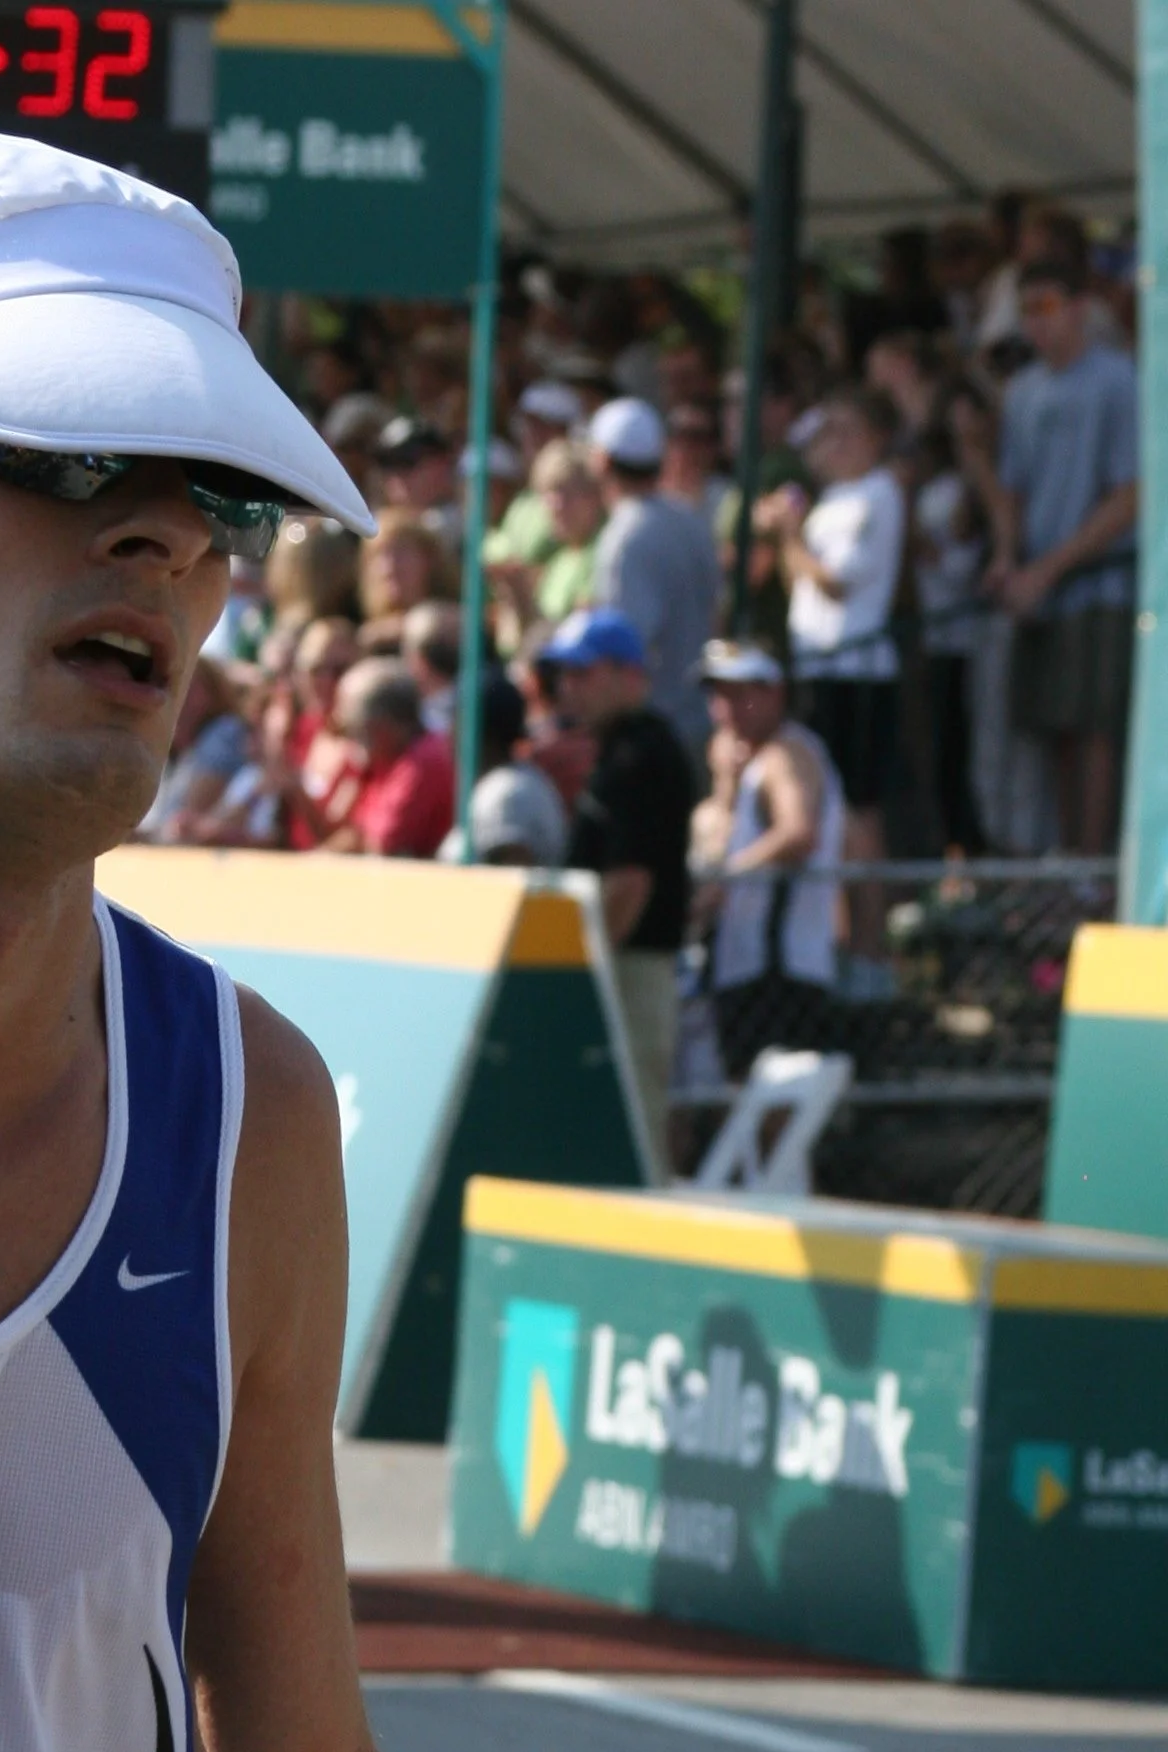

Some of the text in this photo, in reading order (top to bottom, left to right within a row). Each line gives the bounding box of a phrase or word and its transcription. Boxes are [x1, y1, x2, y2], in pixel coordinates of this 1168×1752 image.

[298, 116, 427, 183] Bank
[586, 1324, 912, 1498] LaSalle Bank
